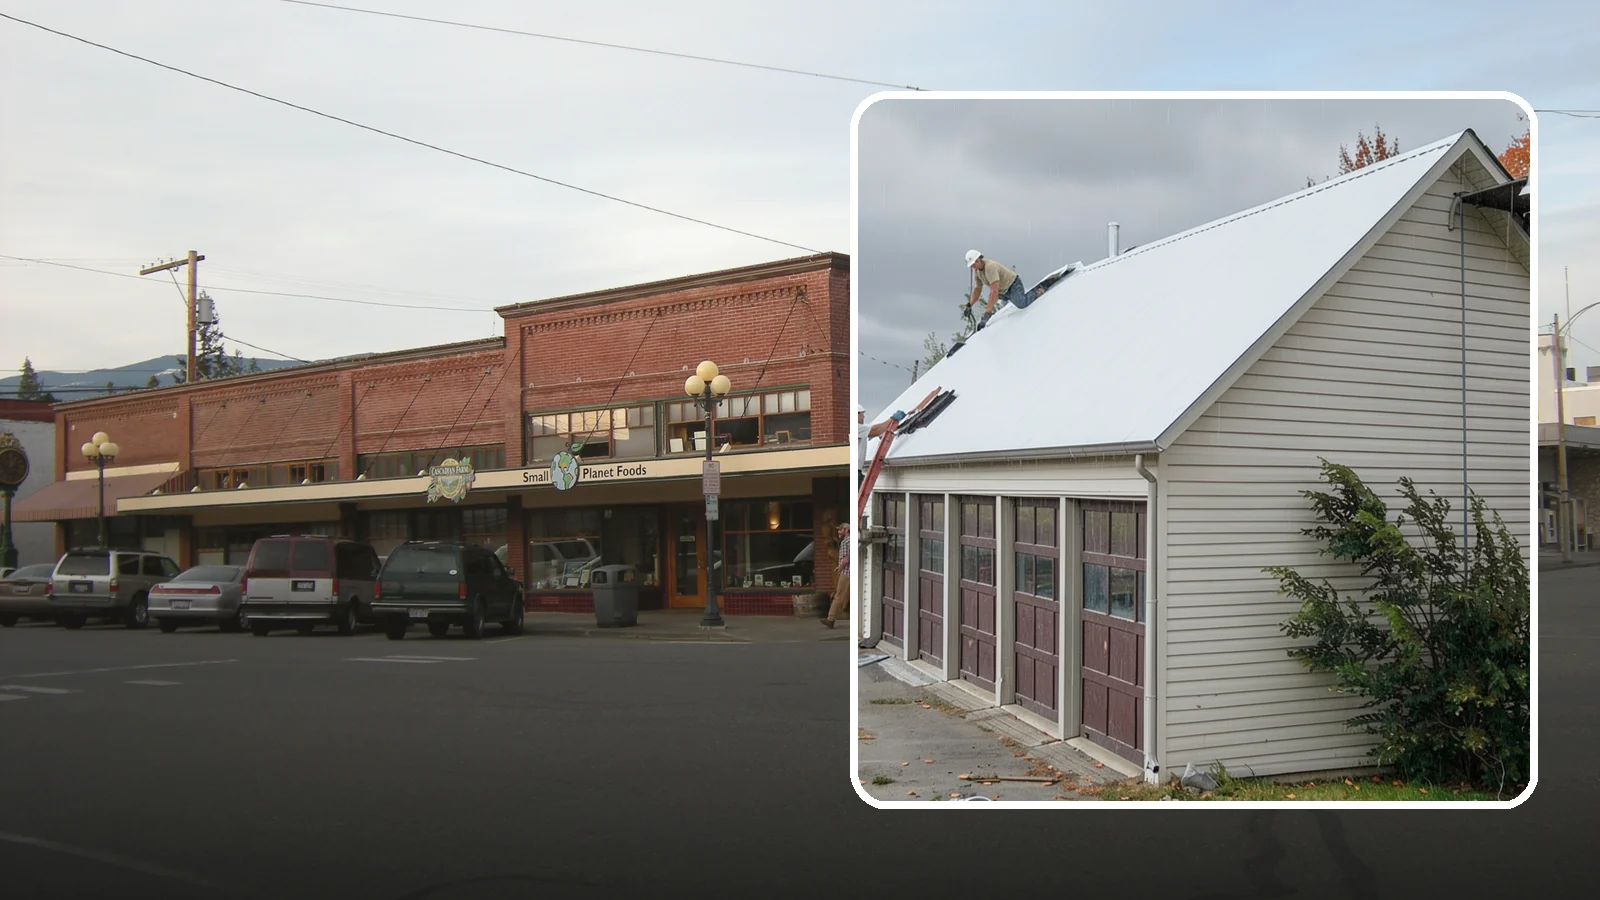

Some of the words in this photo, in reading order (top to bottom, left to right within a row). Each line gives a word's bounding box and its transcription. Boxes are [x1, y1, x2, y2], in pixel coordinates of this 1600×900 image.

[523, 471, 549, 483] Small
[583, 468, 614, 479] Planet
[617, 464, 647, 477] Foods
